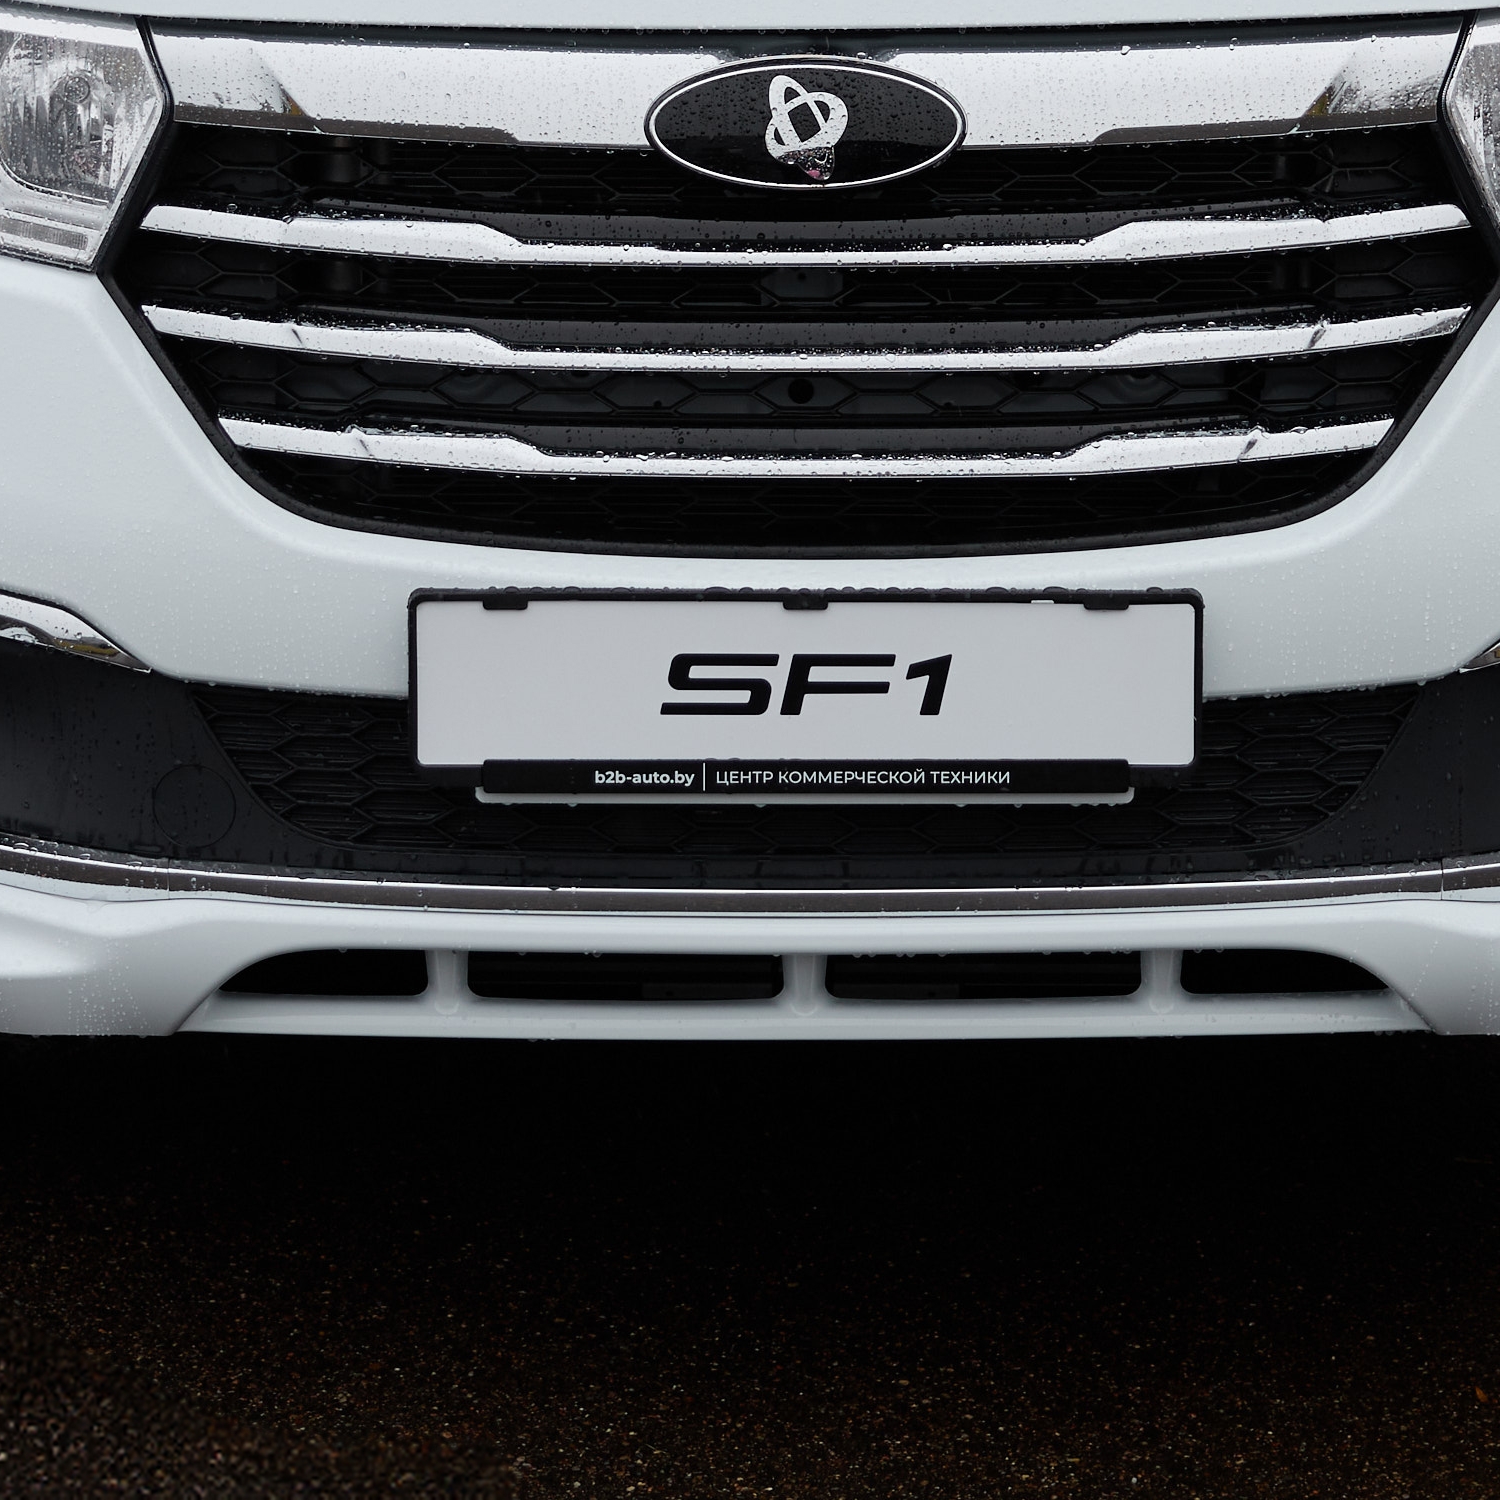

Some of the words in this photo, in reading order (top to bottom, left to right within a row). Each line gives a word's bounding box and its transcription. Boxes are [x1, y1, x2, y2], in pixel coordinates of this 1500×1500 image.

[658, 652, 954, 717] SF1
[593, 770, 696, 787] b2b-auto.by
[715, 770, 775, 786] ЦЕНТР
[777, 767, 925, 785] КОММЕРЧЕСКОЙ
[929, 770, 1011, 785] ТЕХНИКИ
